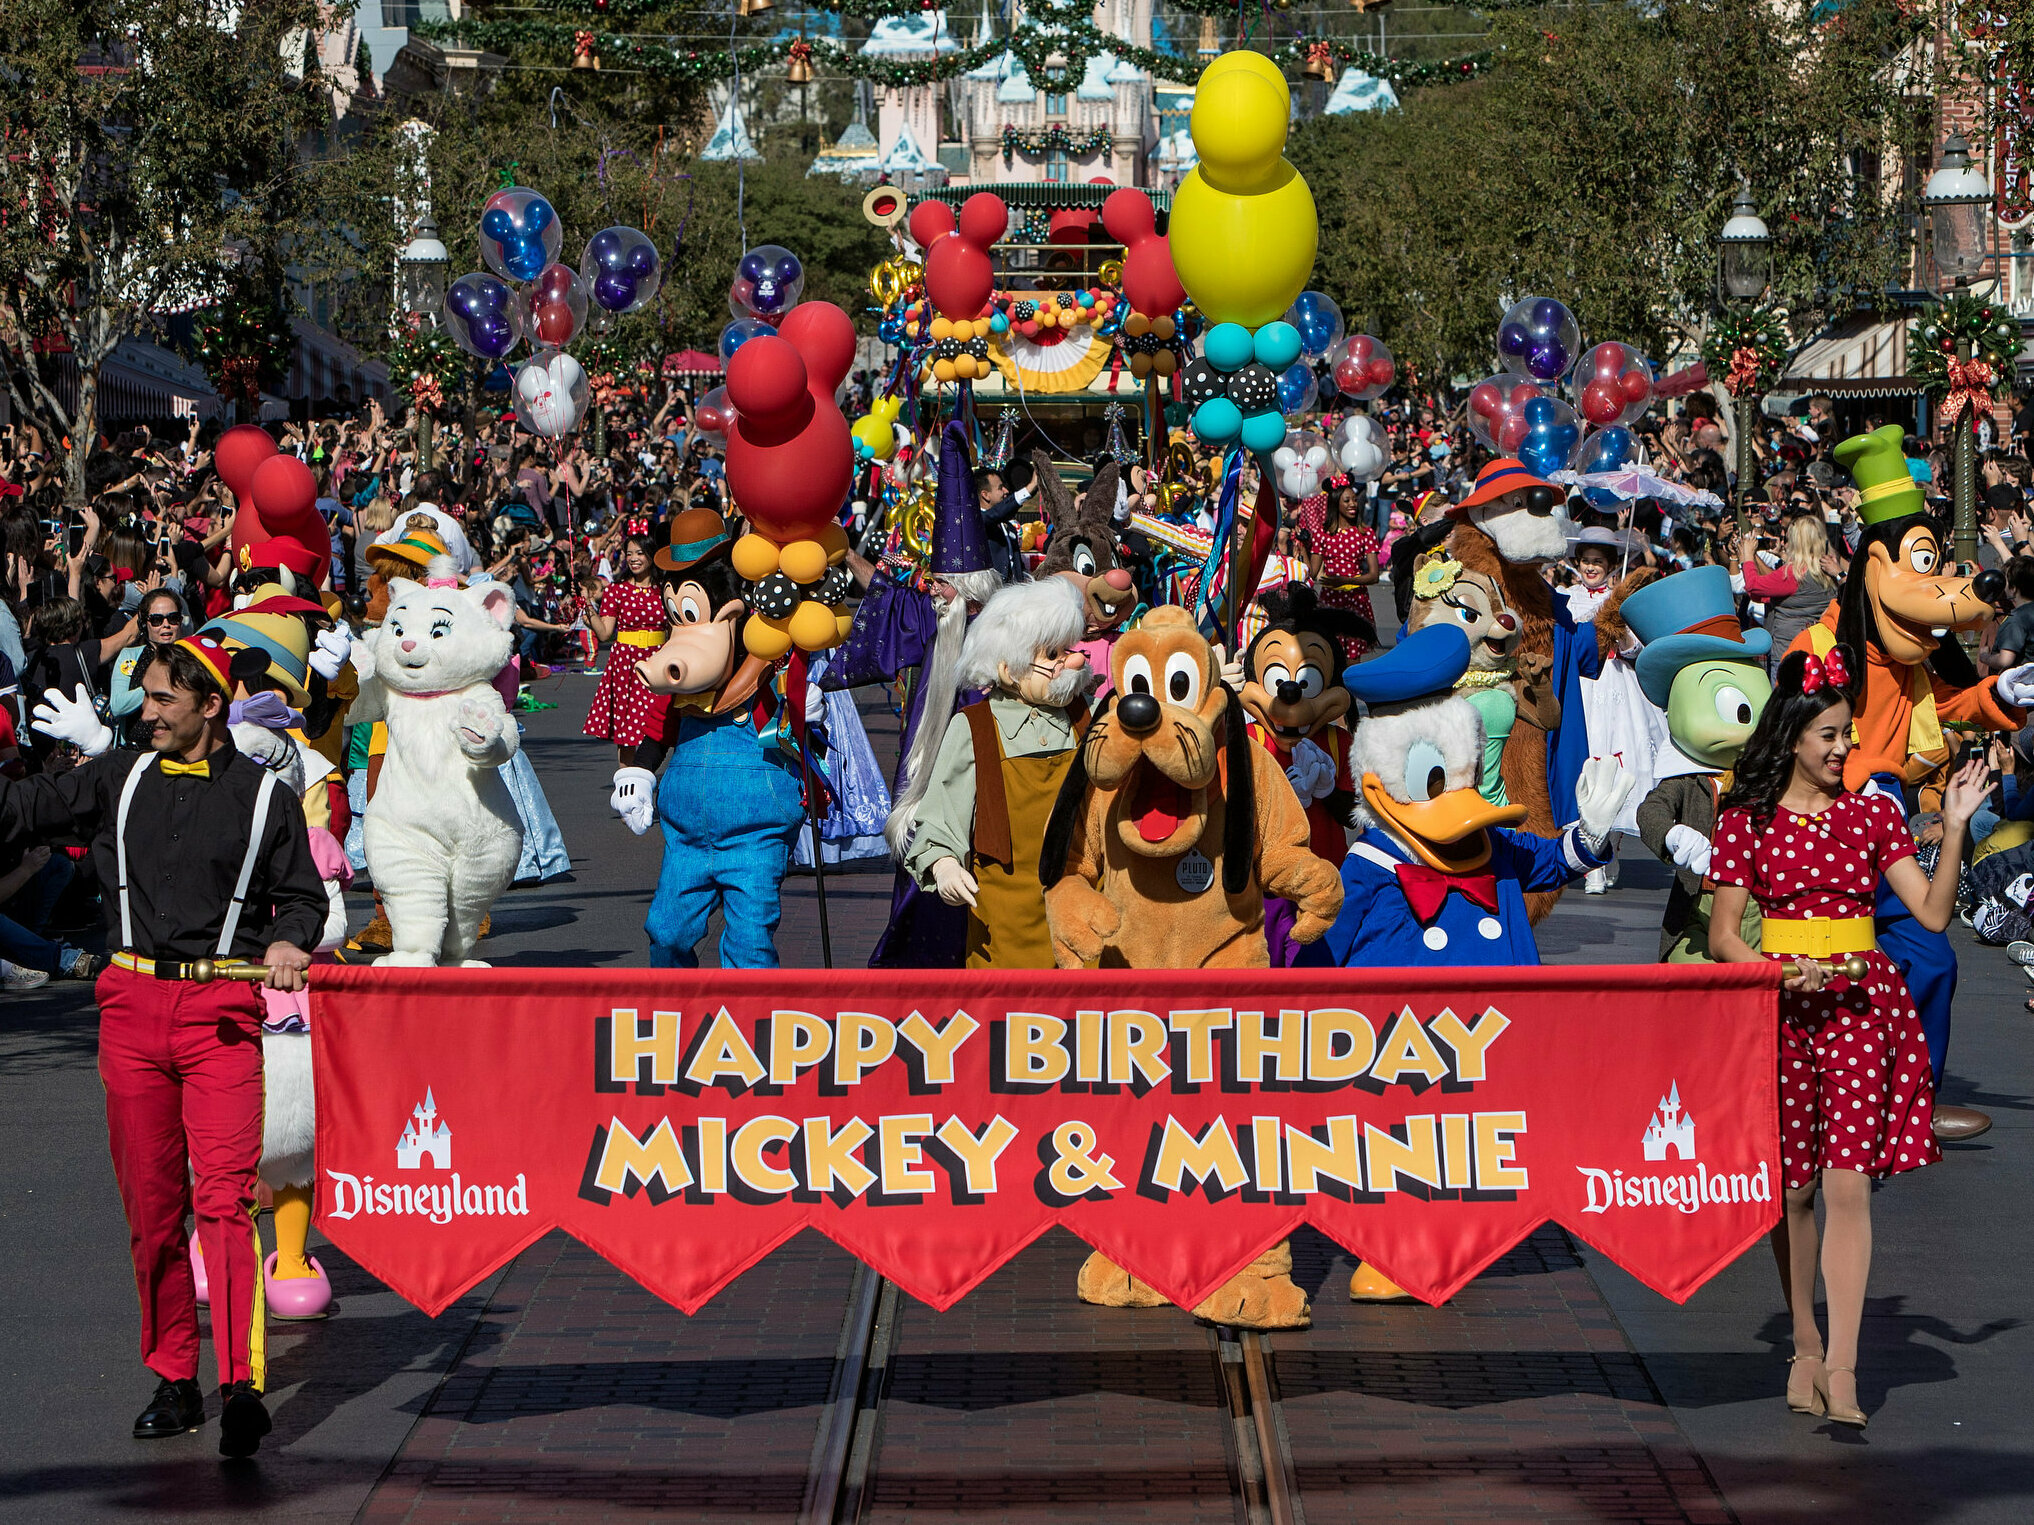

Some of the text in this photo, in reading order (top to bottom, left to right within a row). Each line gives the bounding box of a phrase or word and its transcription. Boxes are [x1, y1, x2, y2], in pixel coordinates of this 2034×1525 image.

[1182, 862, 1208, 874] PLUTO
[609, 1003, 1512, 1088] HAPPY BIRTHDAY
[593, 1110, 1530, 1198] MICKEY & MINNIE
[325, 1168, 530, 1225] Disneyland
[1575, 1160, 1773, 1215] Disneyland
